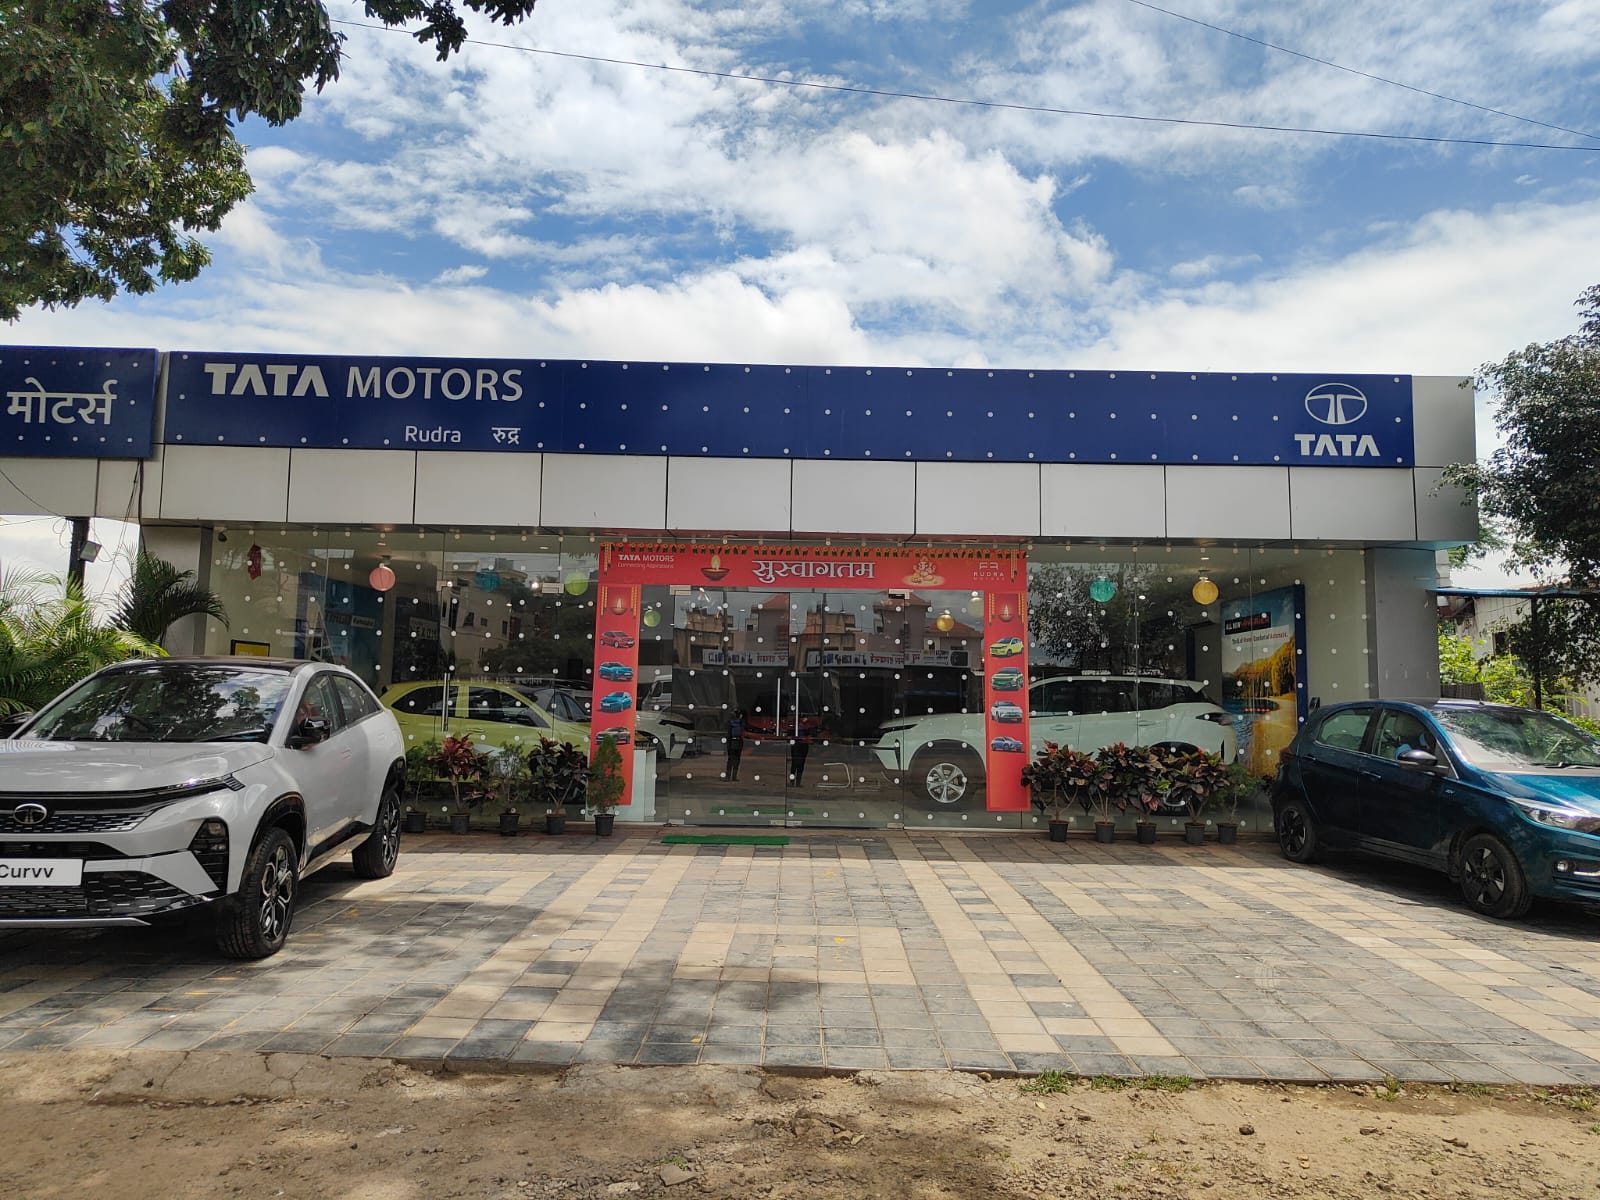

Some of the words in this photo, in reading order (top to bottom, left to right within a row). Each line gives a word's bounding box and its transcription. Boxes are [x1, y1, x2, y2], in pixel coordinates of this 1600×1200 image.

[204, 363, 329, 397] TATA
[346, 366, 523, 402] MOTORS
[6, 376, 118, 425] मोटर्स
[405, 425, 462, 443] Rudra
[491, 426, 521, 445] रुद्र
[1294, 433, 1381, 457] TATA
[642, 554, 675, 562] MOTORS
[751, 559, 876, 584] सुस्वागतम
[0, 864, 54, 878] Curvv
